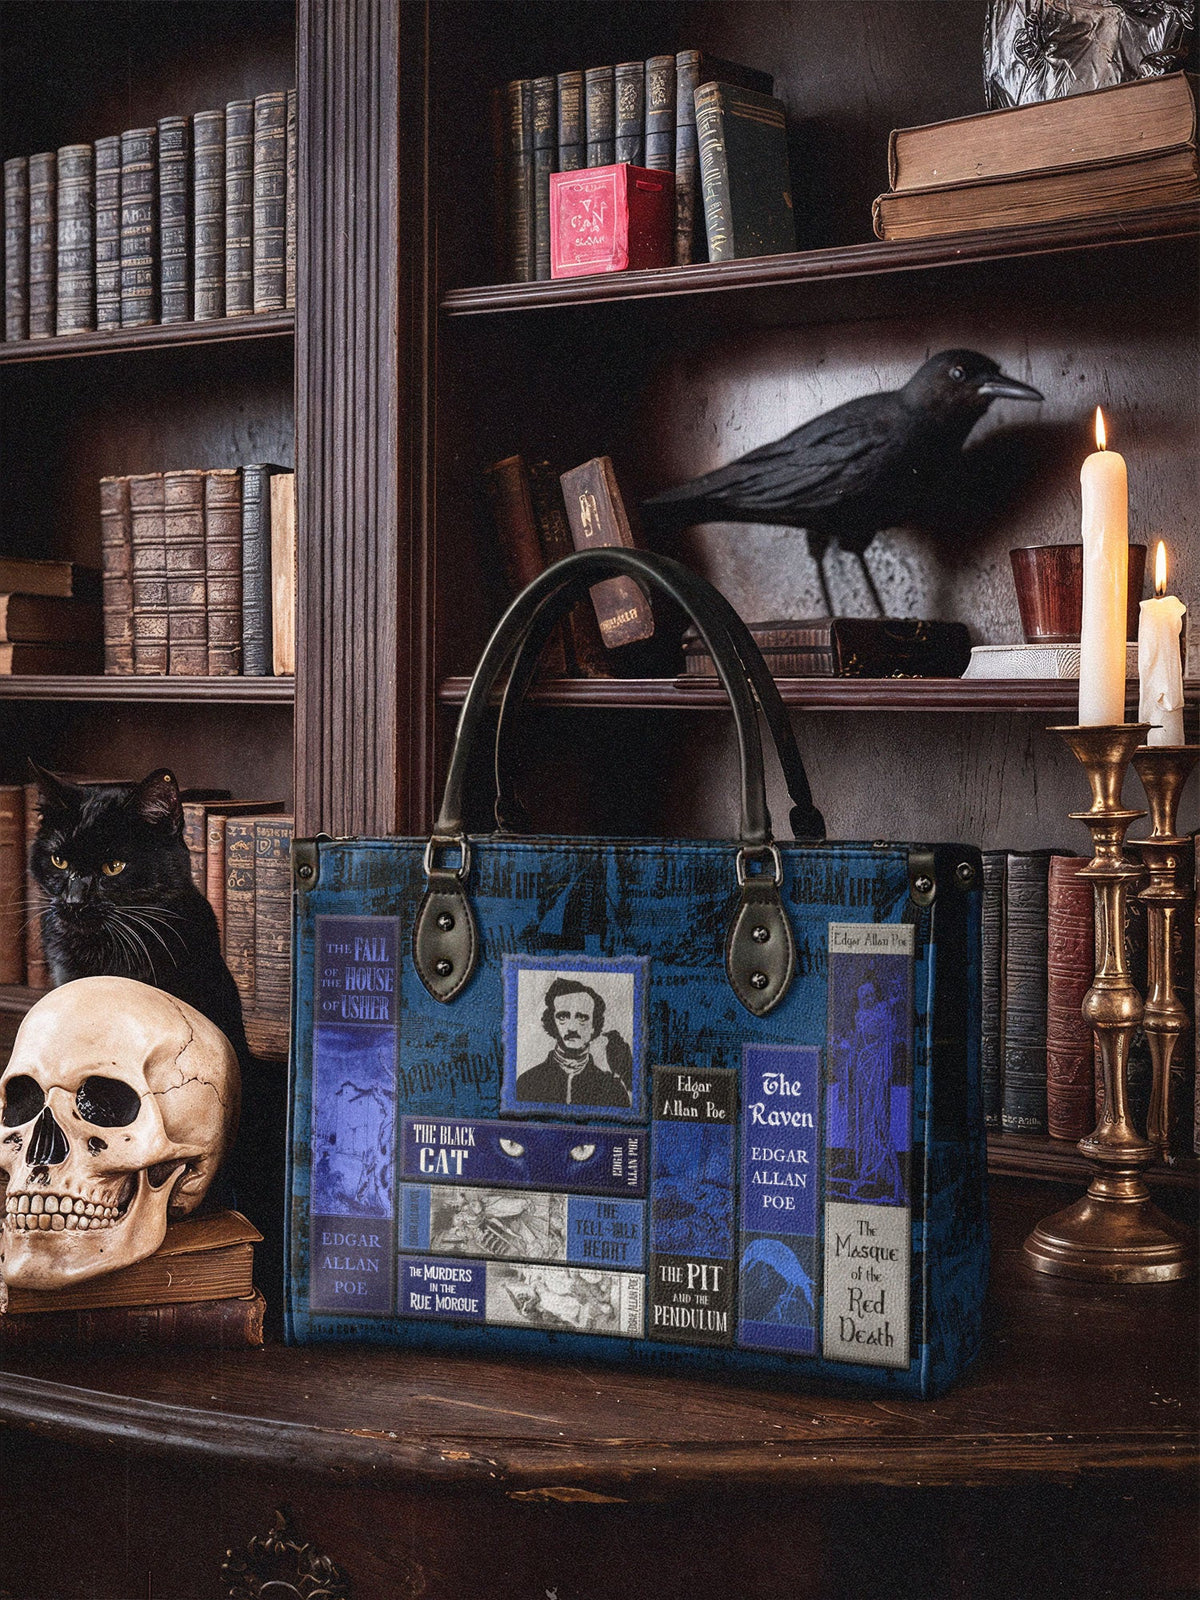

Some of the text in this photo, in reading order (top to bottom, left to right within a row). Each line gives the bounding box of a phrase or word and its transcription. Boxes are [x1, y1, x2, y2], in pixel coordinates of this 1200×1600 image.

[326, 936, 390, 962] THE FALL
[834, 932, 907, 948] Edgar Allan Poe
[321, 966, 394, 992] THE HOUSE
[324, 968, 339, 977] OF
[323, 994, 390, 1020] OF USHER
[677, 1075, 712, 1099] Edgar
[761, 1072, 801, 1096] The
[662, 1099, 726, 1119] Allan Poe
[748, 1102, 814, 1128] Raven
[413, 1124, 476, 1147] THE BLACK
[419, 1147, 469, 1175] CAT
[612, 1146, 623, 1177] EDGAR
[627, 1138, 639, 1187] ALLAN POE
[752, 1147, 810, 1164] EDGAR
[751, 1170, 807, 1188] ALLAN
[596, 1202, 619, 1219] THE
[762, 1194, 796, 1210] POE
[857, 1220, 878, 1237] The
[322, 1232, 382, 1247] EDGAR
[836, 1233, 899, 1263] Masque
[582, 1239, 629, 1262] HEART
[321, 1256, 380, 1272] ALLAN
[409, 1264, 473, 1282] THE MURDERS
[850, 1265, 882, 1282] of the
[334, 1280, 369, 1295] POE
[659, 1263, 724, 1291] THE PIT
[429, 1282, 457, 1294] IN THE
[410, 1292, 479, 1312] RUE MORGUE
[672, 1293, 710, 1305] AND THE
[847, 1287, 885, 1319] Red
[653, 1304, 728, 1332] PENDULUM
[839, 1315, 894, 1347] Death
